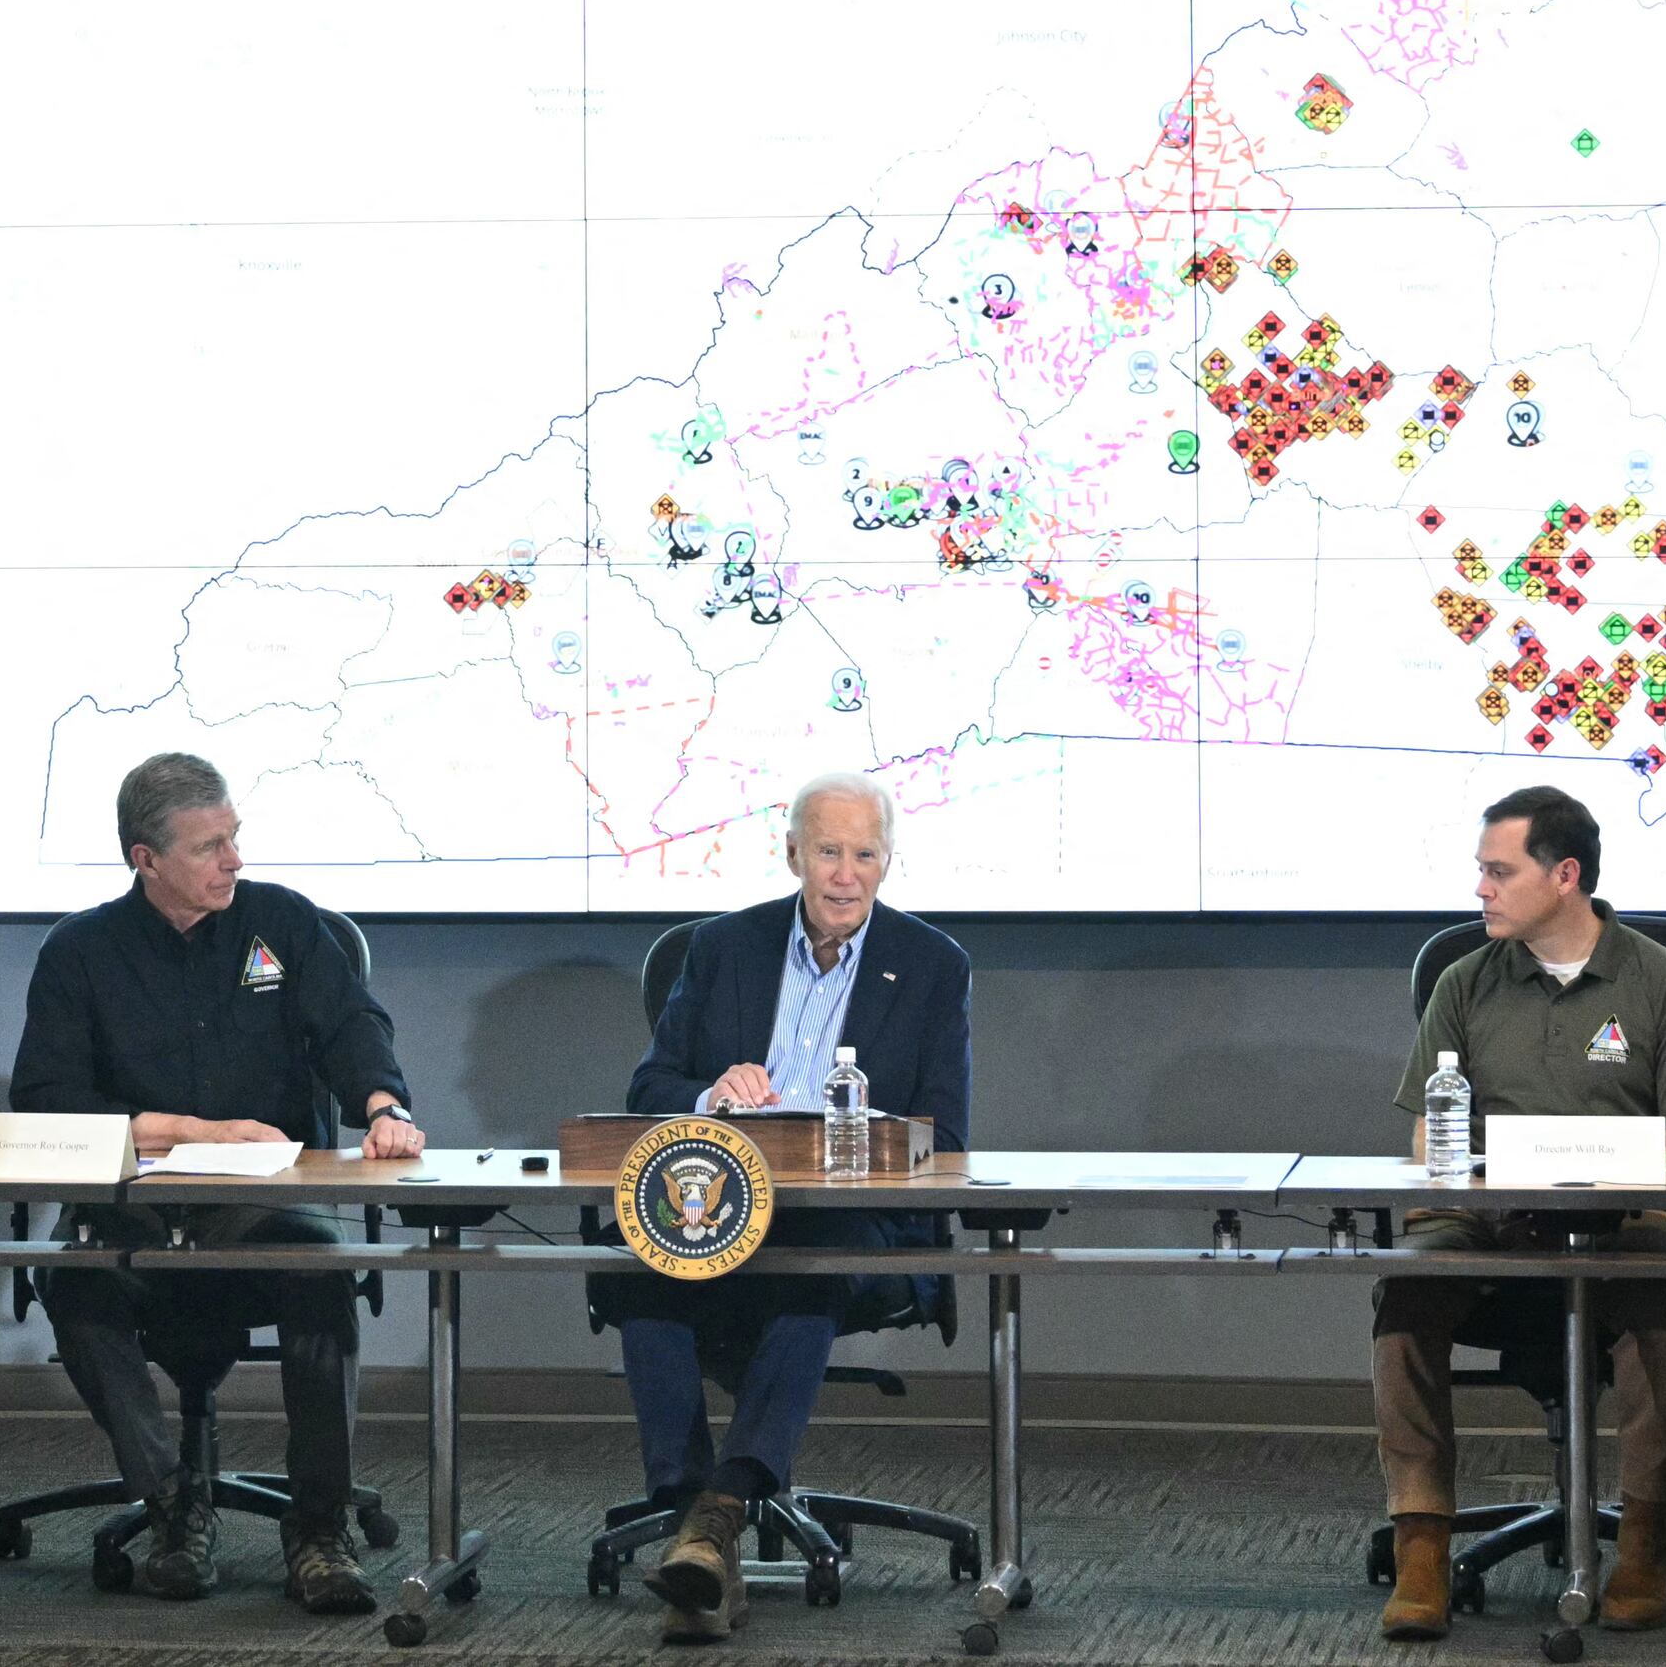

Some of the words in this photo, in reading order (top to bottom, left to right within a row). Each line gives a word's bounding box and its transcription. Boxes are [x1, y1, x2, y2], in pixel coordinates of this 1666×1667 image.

[994, 285, 1004, 295] 3
[1512, 411, 1533, 426] 10
[853, 469, 860, 479] 2
[864, 496, 873, 507] 9
[843, 678, 851, 688] 9
[1588, 1054, 1627, 1064] DIRECTOR
[696, 1126, 711, 1136] OF
[714, 1130, 733, 1145] THE
[40, 1141, 56, 1151] Roy
[59, 1142, 89, 1152] Cooper
[1535, 1144, 1571, 1154] Director
[1575, 1144, 1596, 1153] Will
[1598, 1145, 1616, 1155] Ray
[621, 1124, 691, 1194] PRESIDENT
[736, 1144, 768, 1210] UNITED
[622, 1200, 633, 1222] THE
[628, 1225, 640, 1239] OF
[707, 1225, 760, 1272] STATES
[639, 1242, 679, 1271] SEAL
